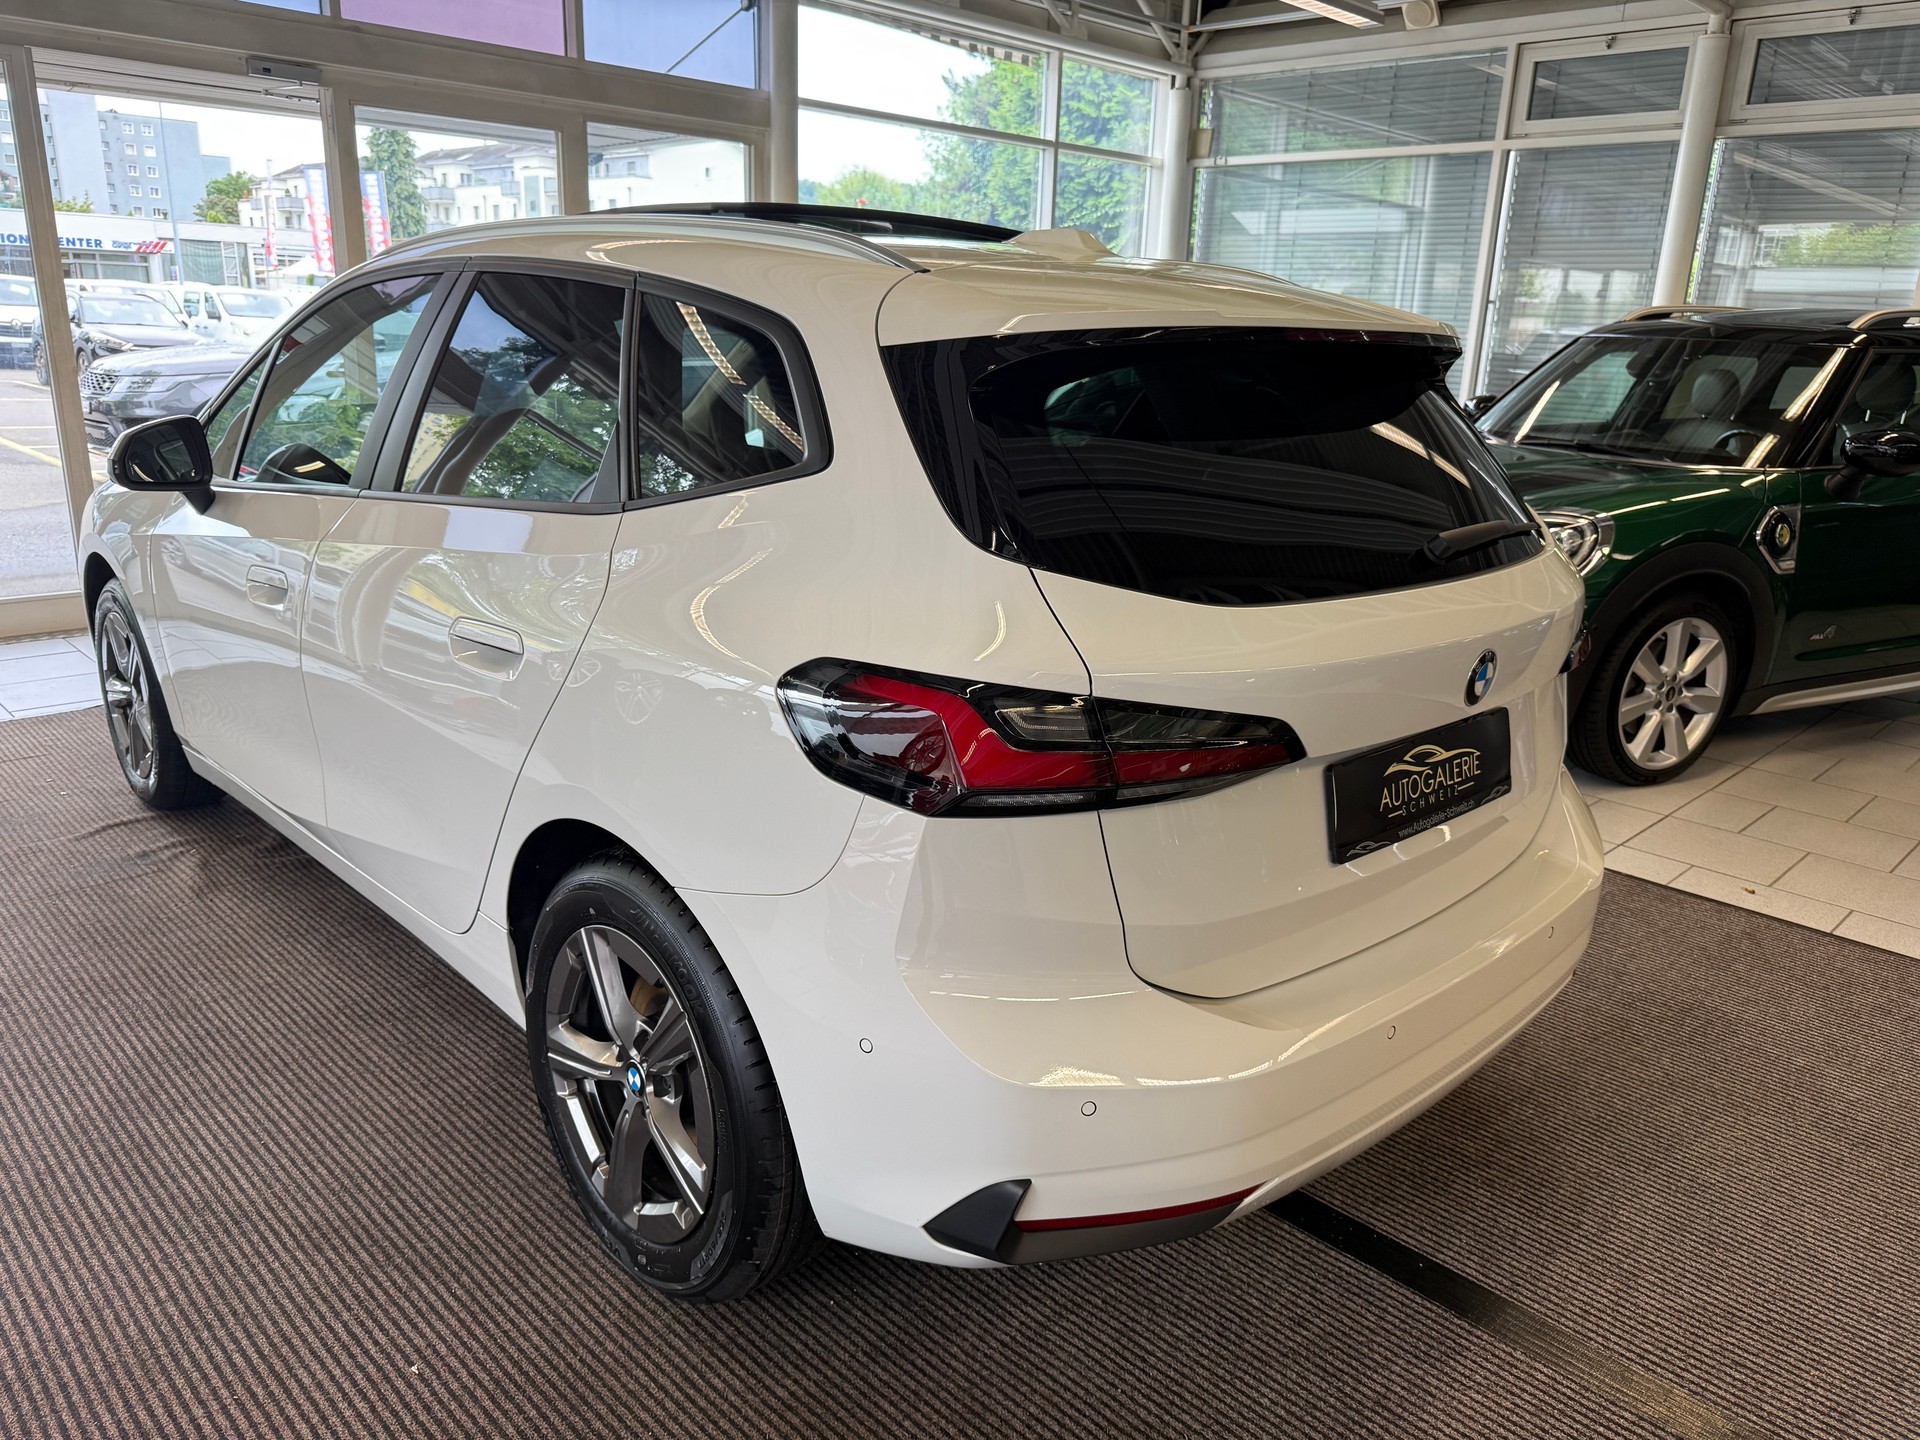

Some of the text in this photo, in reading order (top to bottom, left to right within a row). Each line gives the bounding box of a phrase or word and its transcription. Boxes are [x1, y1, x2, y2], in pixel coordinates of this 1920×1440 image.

[58, 237, 103, 248] ENTER
[1379, 752, 1482, 812] AUTOGALERIE
[1401, 784, 1459, 816] SCHWEIZ
